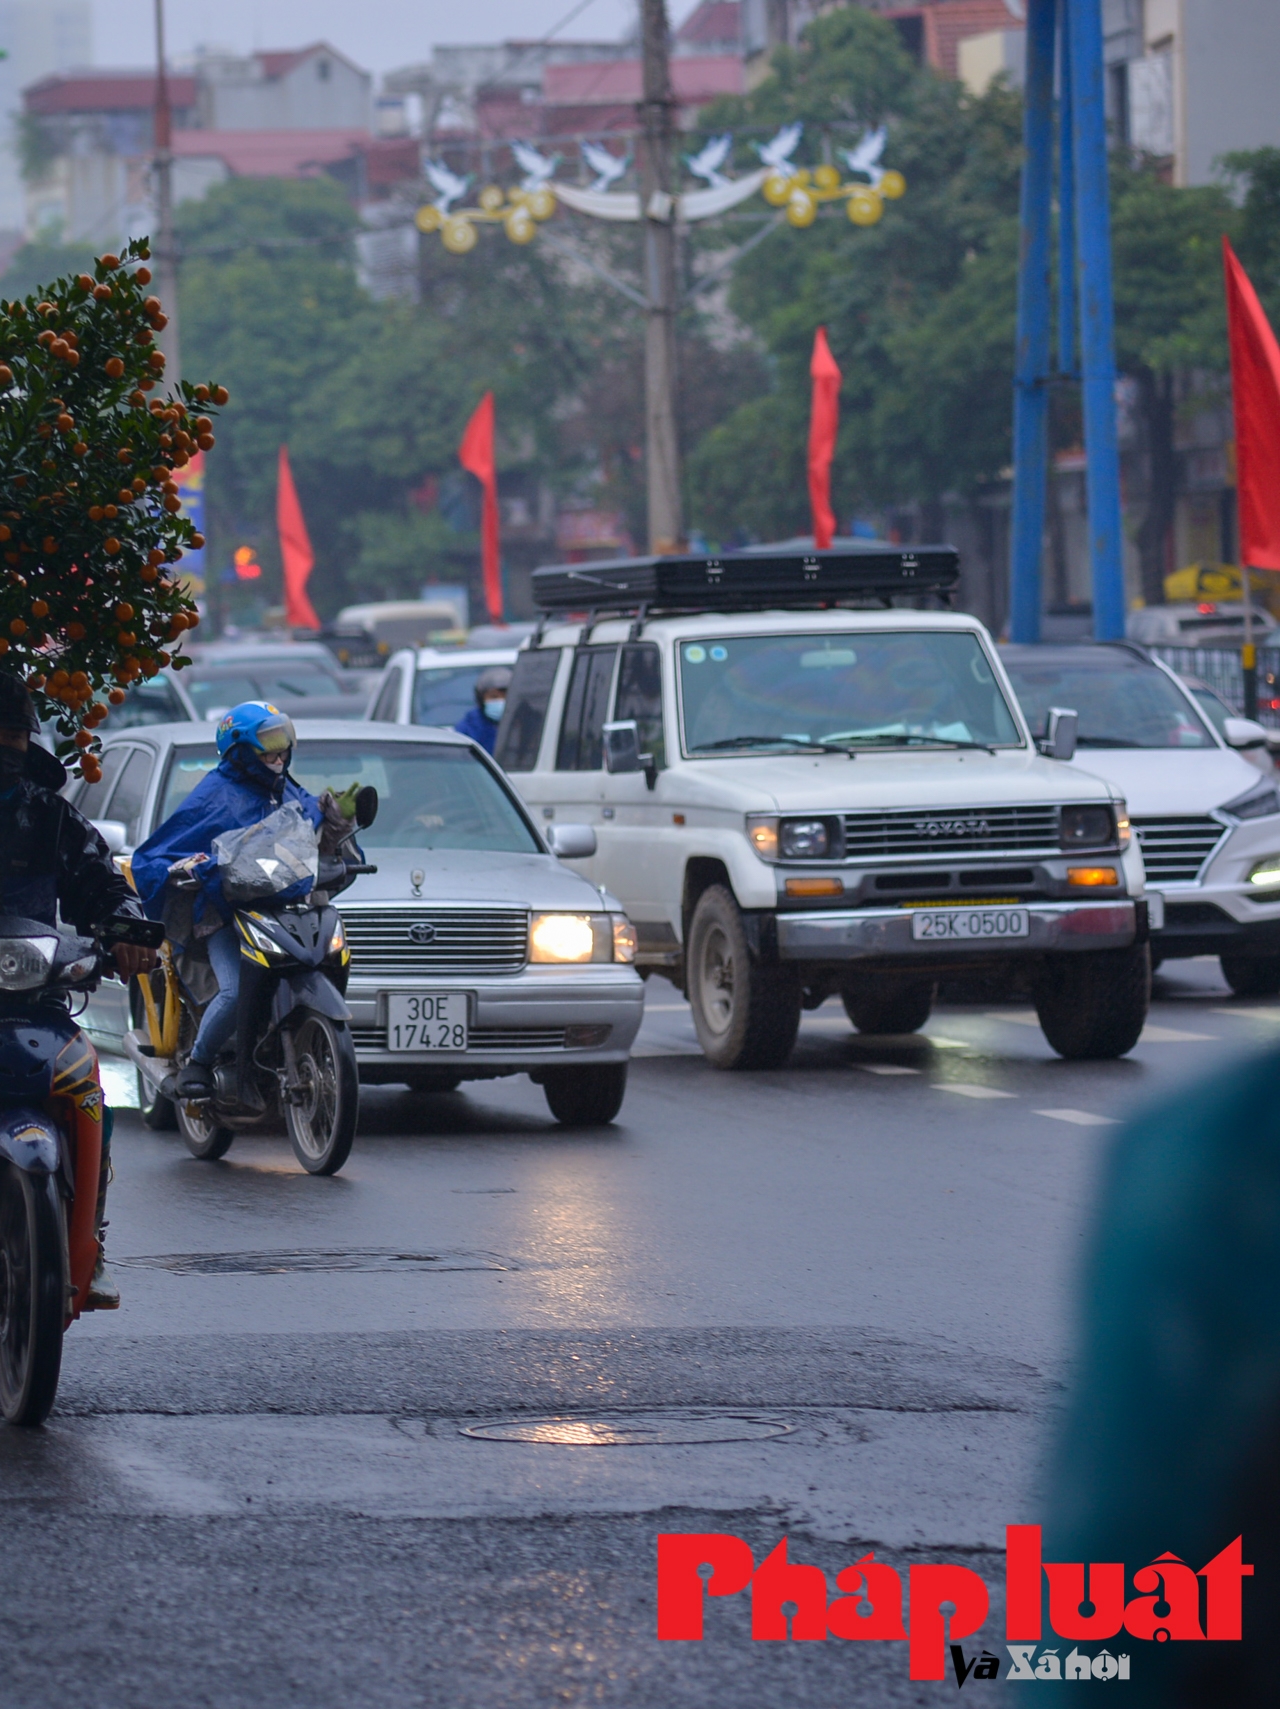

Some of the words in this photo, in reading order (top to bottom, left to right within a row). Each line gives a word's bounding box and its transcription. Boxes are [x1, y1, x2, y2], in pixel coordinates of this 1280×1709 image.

[914, 819, 991, 836] TOYOTA
[407, 997, 448, 1020] 30E
[394, 1024, 464, 1048] 174.28
